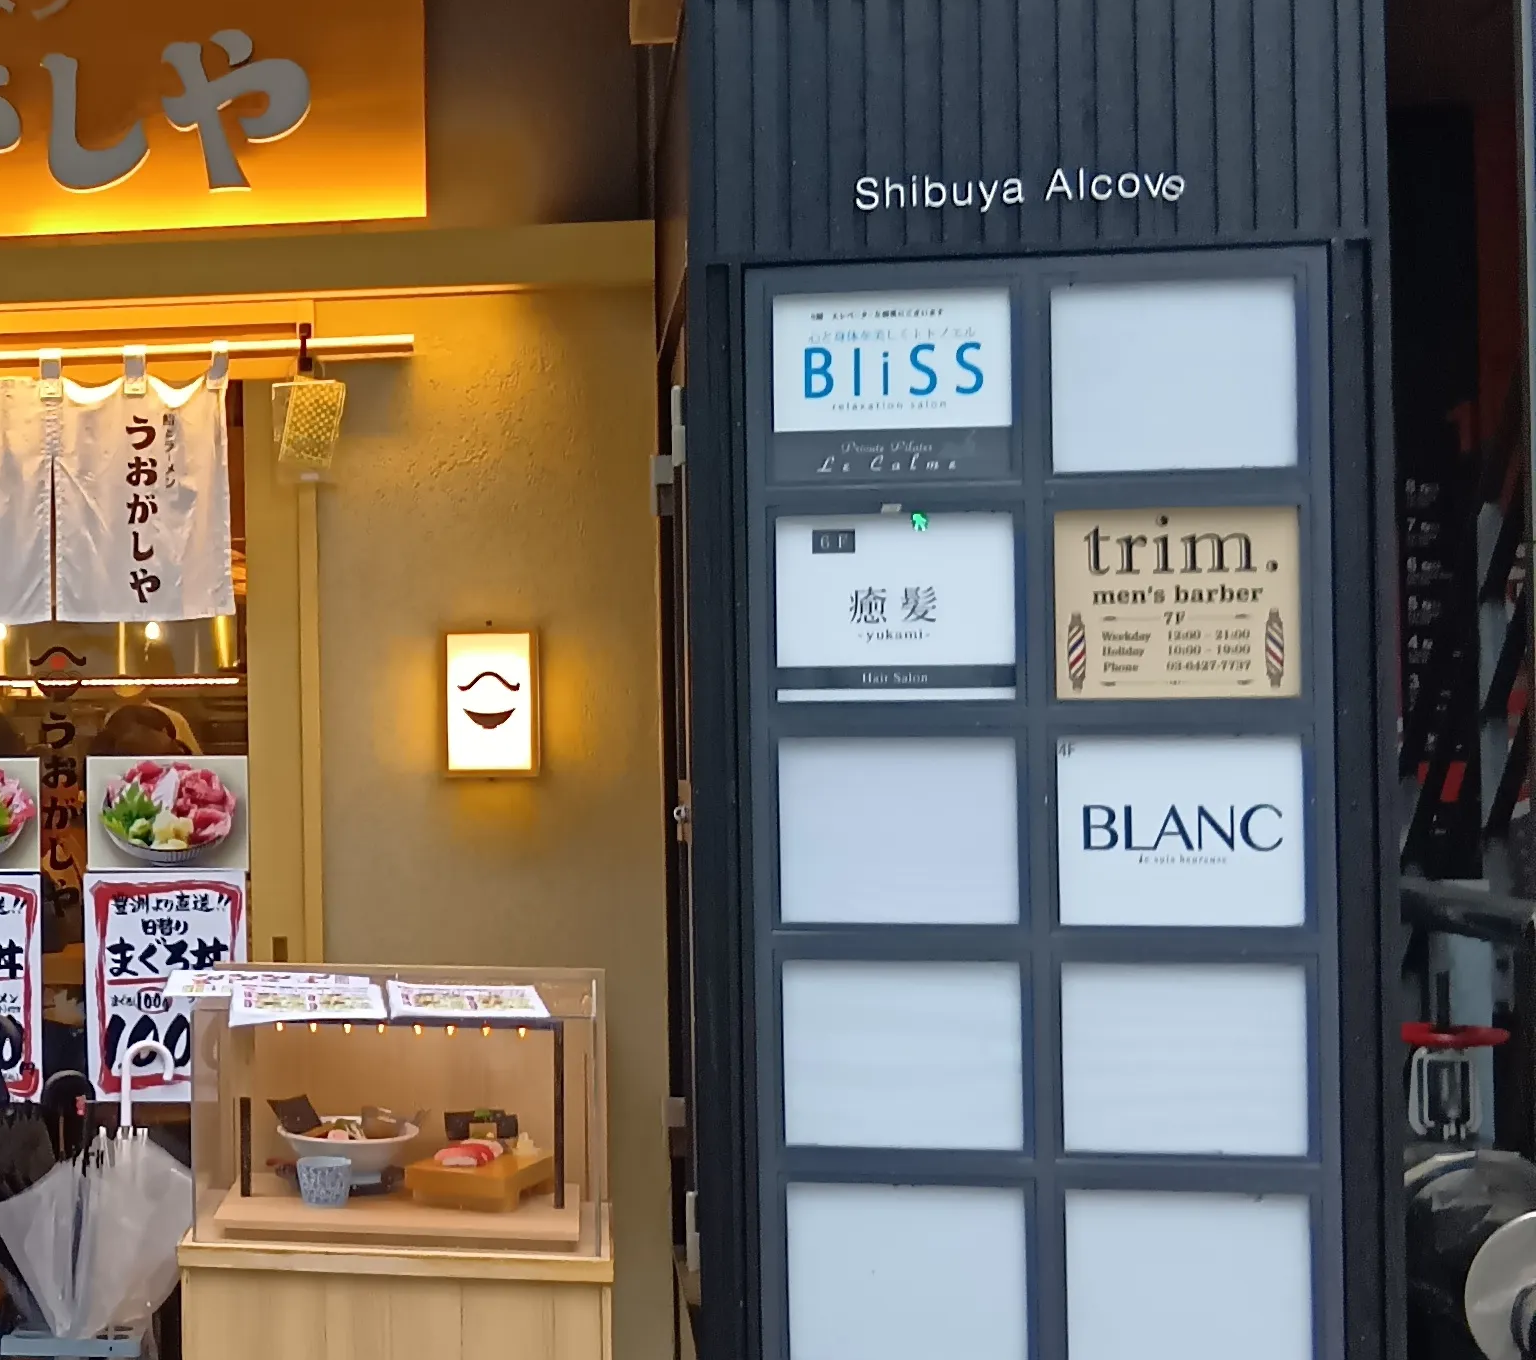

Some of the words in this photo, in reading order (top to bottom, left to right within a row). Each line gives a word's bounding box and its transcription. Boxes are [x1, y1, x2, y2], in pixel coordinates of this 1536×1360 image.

[855, 175, 1025, 213] Shibuya
[1046, 167, 1186, 202] Alcove
[832, 401, 904, 412] relaxation
[910, 400, 947, 411] salon
[125, 414, 161, 604] うおがしや
[1092, 585, 1166, 606] men's
[1174, 583, 1264, 605] barber
[1163, 610, 1186, 626] 7F
[1101, 631, 1152, 643] Weekday
[1102, 646, 1145, 658] Holiday
[1103, 662, 1139, 673] Phone
[893, 672, 928, 684] Salon
[42, 711, 80, 918] うおがしや
[1082, 803, 1284, 852] BLANC
[141, 917, 189, 936] 日替り
